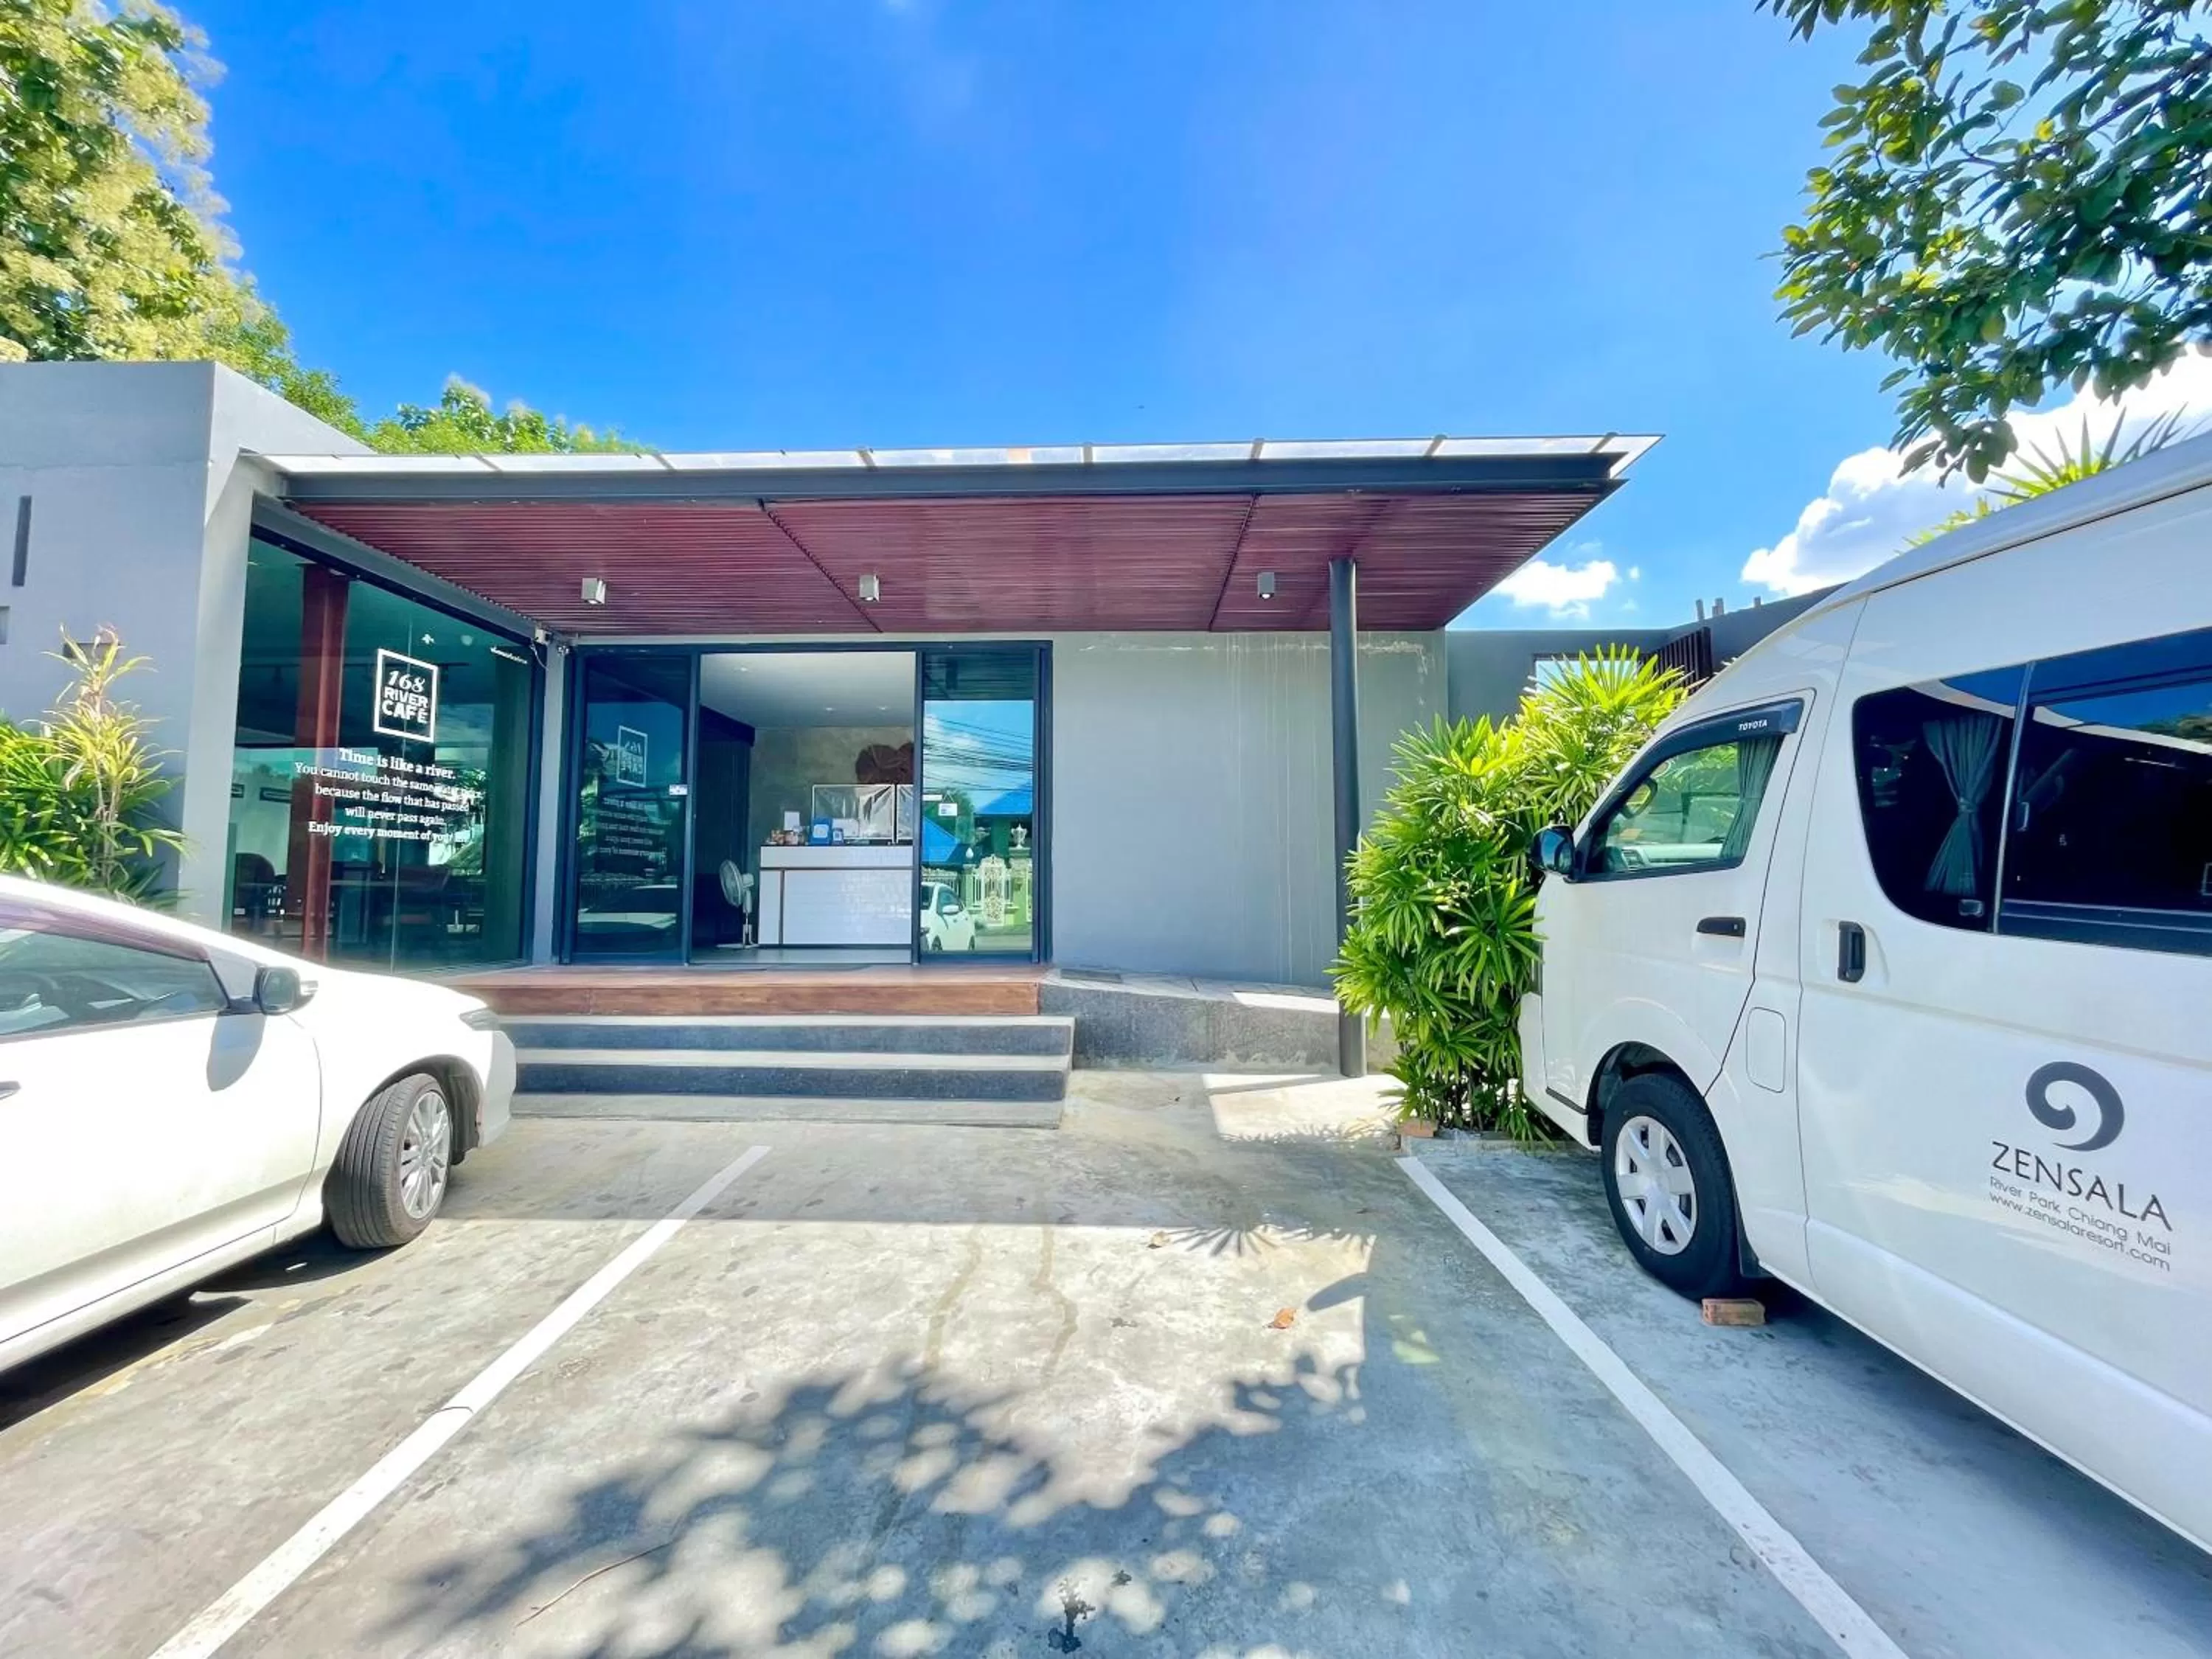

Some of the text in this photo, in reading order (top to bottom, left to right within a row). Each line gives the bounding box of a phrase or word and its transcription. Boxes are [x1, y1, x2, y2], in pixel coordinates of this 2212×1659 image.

[389, 670, 425, 692] 168
[384, 686, 428, 708] RIVER
[1739, 720, 1767, 731] TOYOTA
[295, 762, 318, 775] You
[321, 768, 358, 781] cannot
[361, 772, 390, 785] touch
[392, 776, 408, 788] the
[409, 781, 434, 792] same
[339, 748, 456, 779] Time is like a river.
[315, 783, 470, 812] because the flow that has passed
[344, 806, 365, 818] will
[368, 810, 395, 821] never
[397, 813, 418, 824] pass
[308, 821, 343, 836] Enjoy
[344, 826, 375, 839] every
[377, 828, 419, 840] moment
[420, 830, 432, 841] of
[1992, 1141, 2172, 1231] ZENSALA
[1990, 1176, 2171, 1255] River Park Chiang Mai
[1989, 1191, 2170, 1272] www.zensalaresort.com
